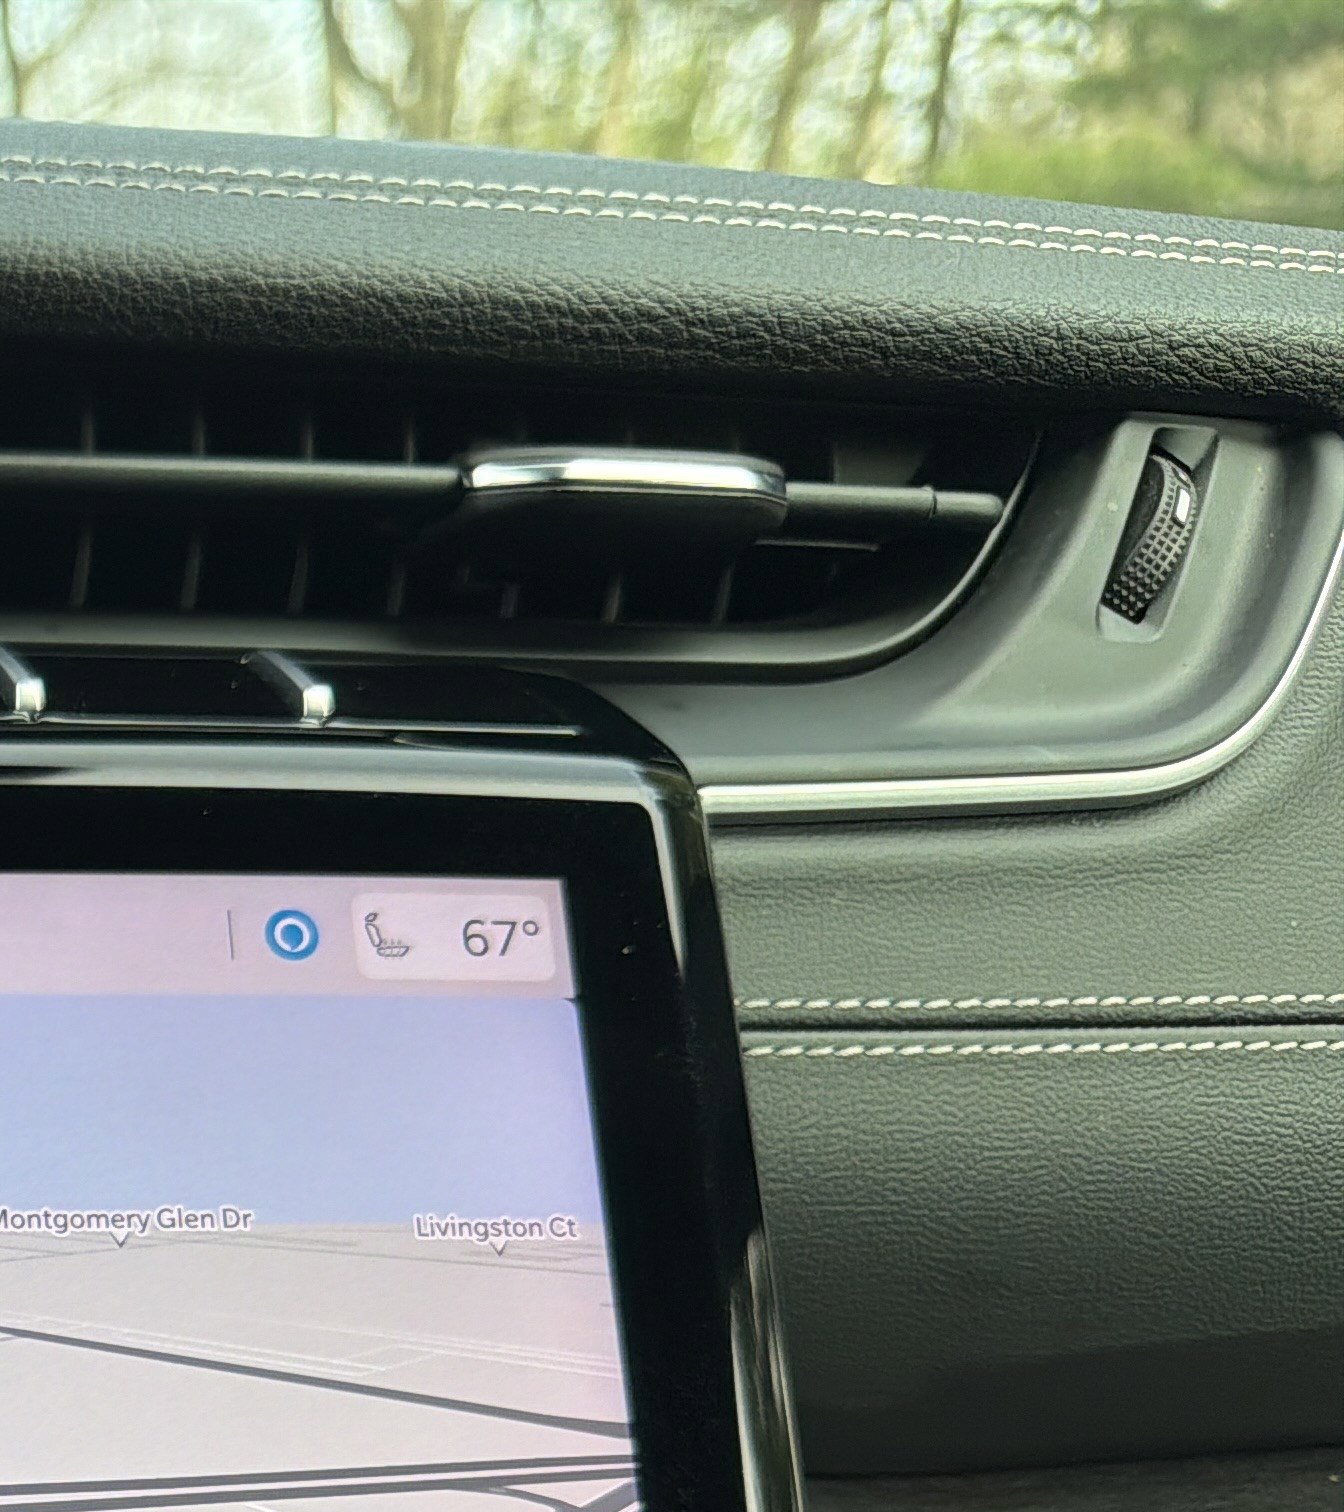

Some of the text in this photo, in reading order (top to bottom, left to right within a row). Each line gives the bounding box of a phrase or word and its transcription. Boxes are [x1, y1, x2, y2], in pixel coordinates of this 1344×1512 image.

[461, 918, 541, 959] 67°
[155, 1207, 215, 1231] Glen
[221, 1207, 254, 1231] Dr
[416, 1214, 578, 1242] Livingston Ct
